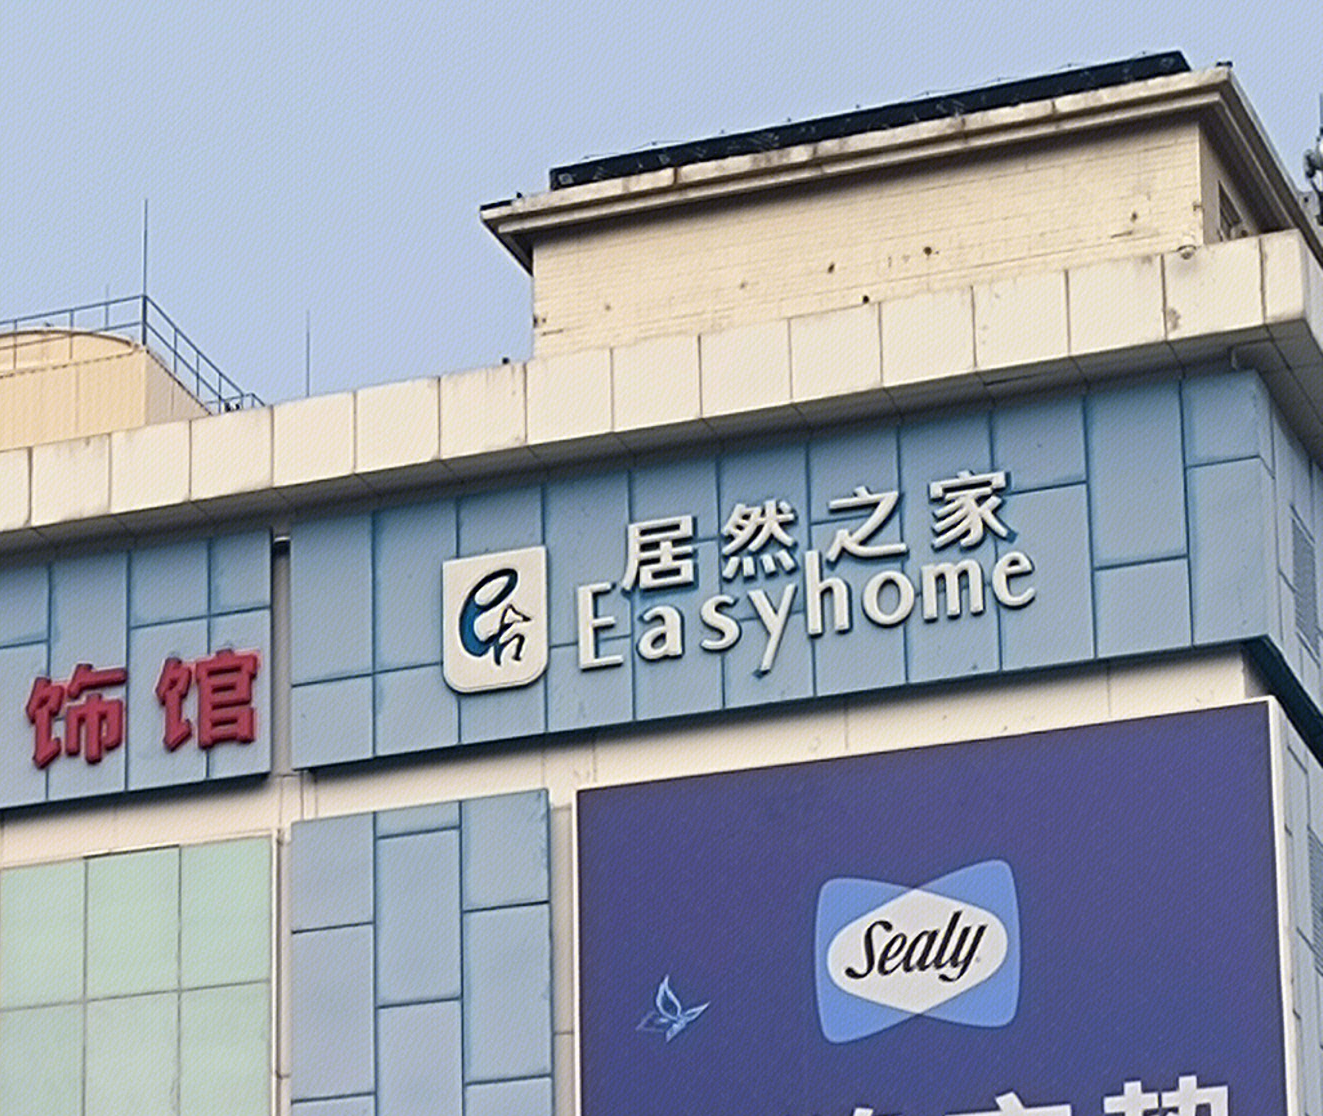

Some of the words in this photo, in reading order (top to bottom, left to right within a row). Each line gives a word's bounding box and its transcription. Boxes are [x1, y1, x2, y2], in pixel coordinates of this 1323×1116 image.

[621, 470, 1013, 592] 居然之家
[578, 548, 1035, 676] Easyhome
[844, 909, 988, 982] Sealy
